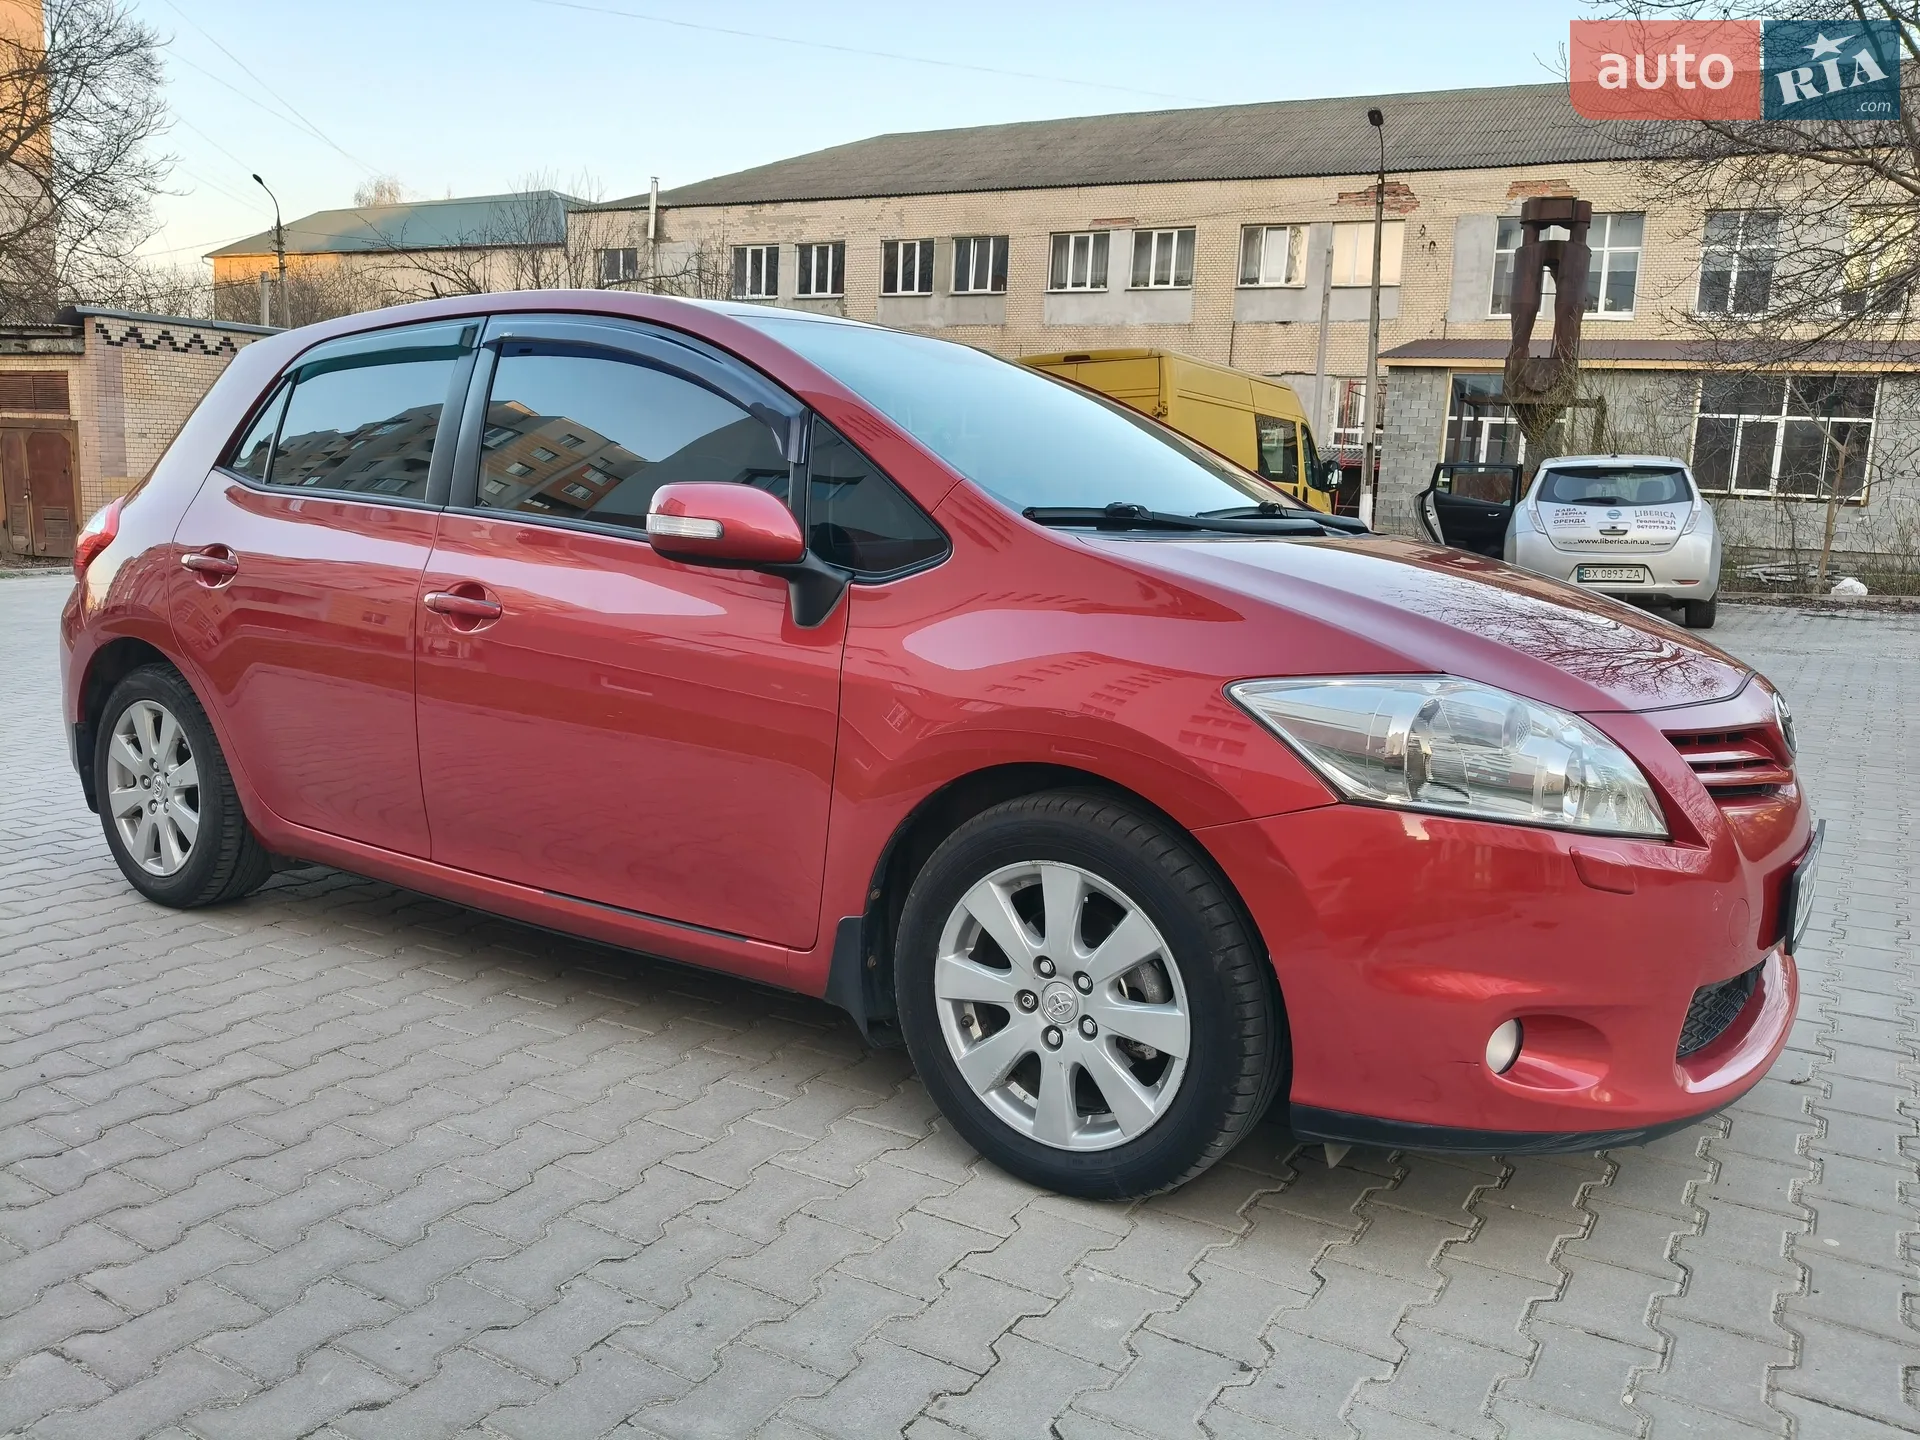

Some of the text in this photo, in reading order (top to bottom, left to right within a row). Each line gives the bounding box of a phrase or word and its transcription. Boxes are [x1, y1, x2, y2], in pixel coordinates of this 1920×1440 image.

[1634, 510, 1676, 519] LIBERICA
[1584, 569, 1598, 579] BX
[1601, 569, 1624, 579] 0893
[1626, 569, 1641, 579] ZA
